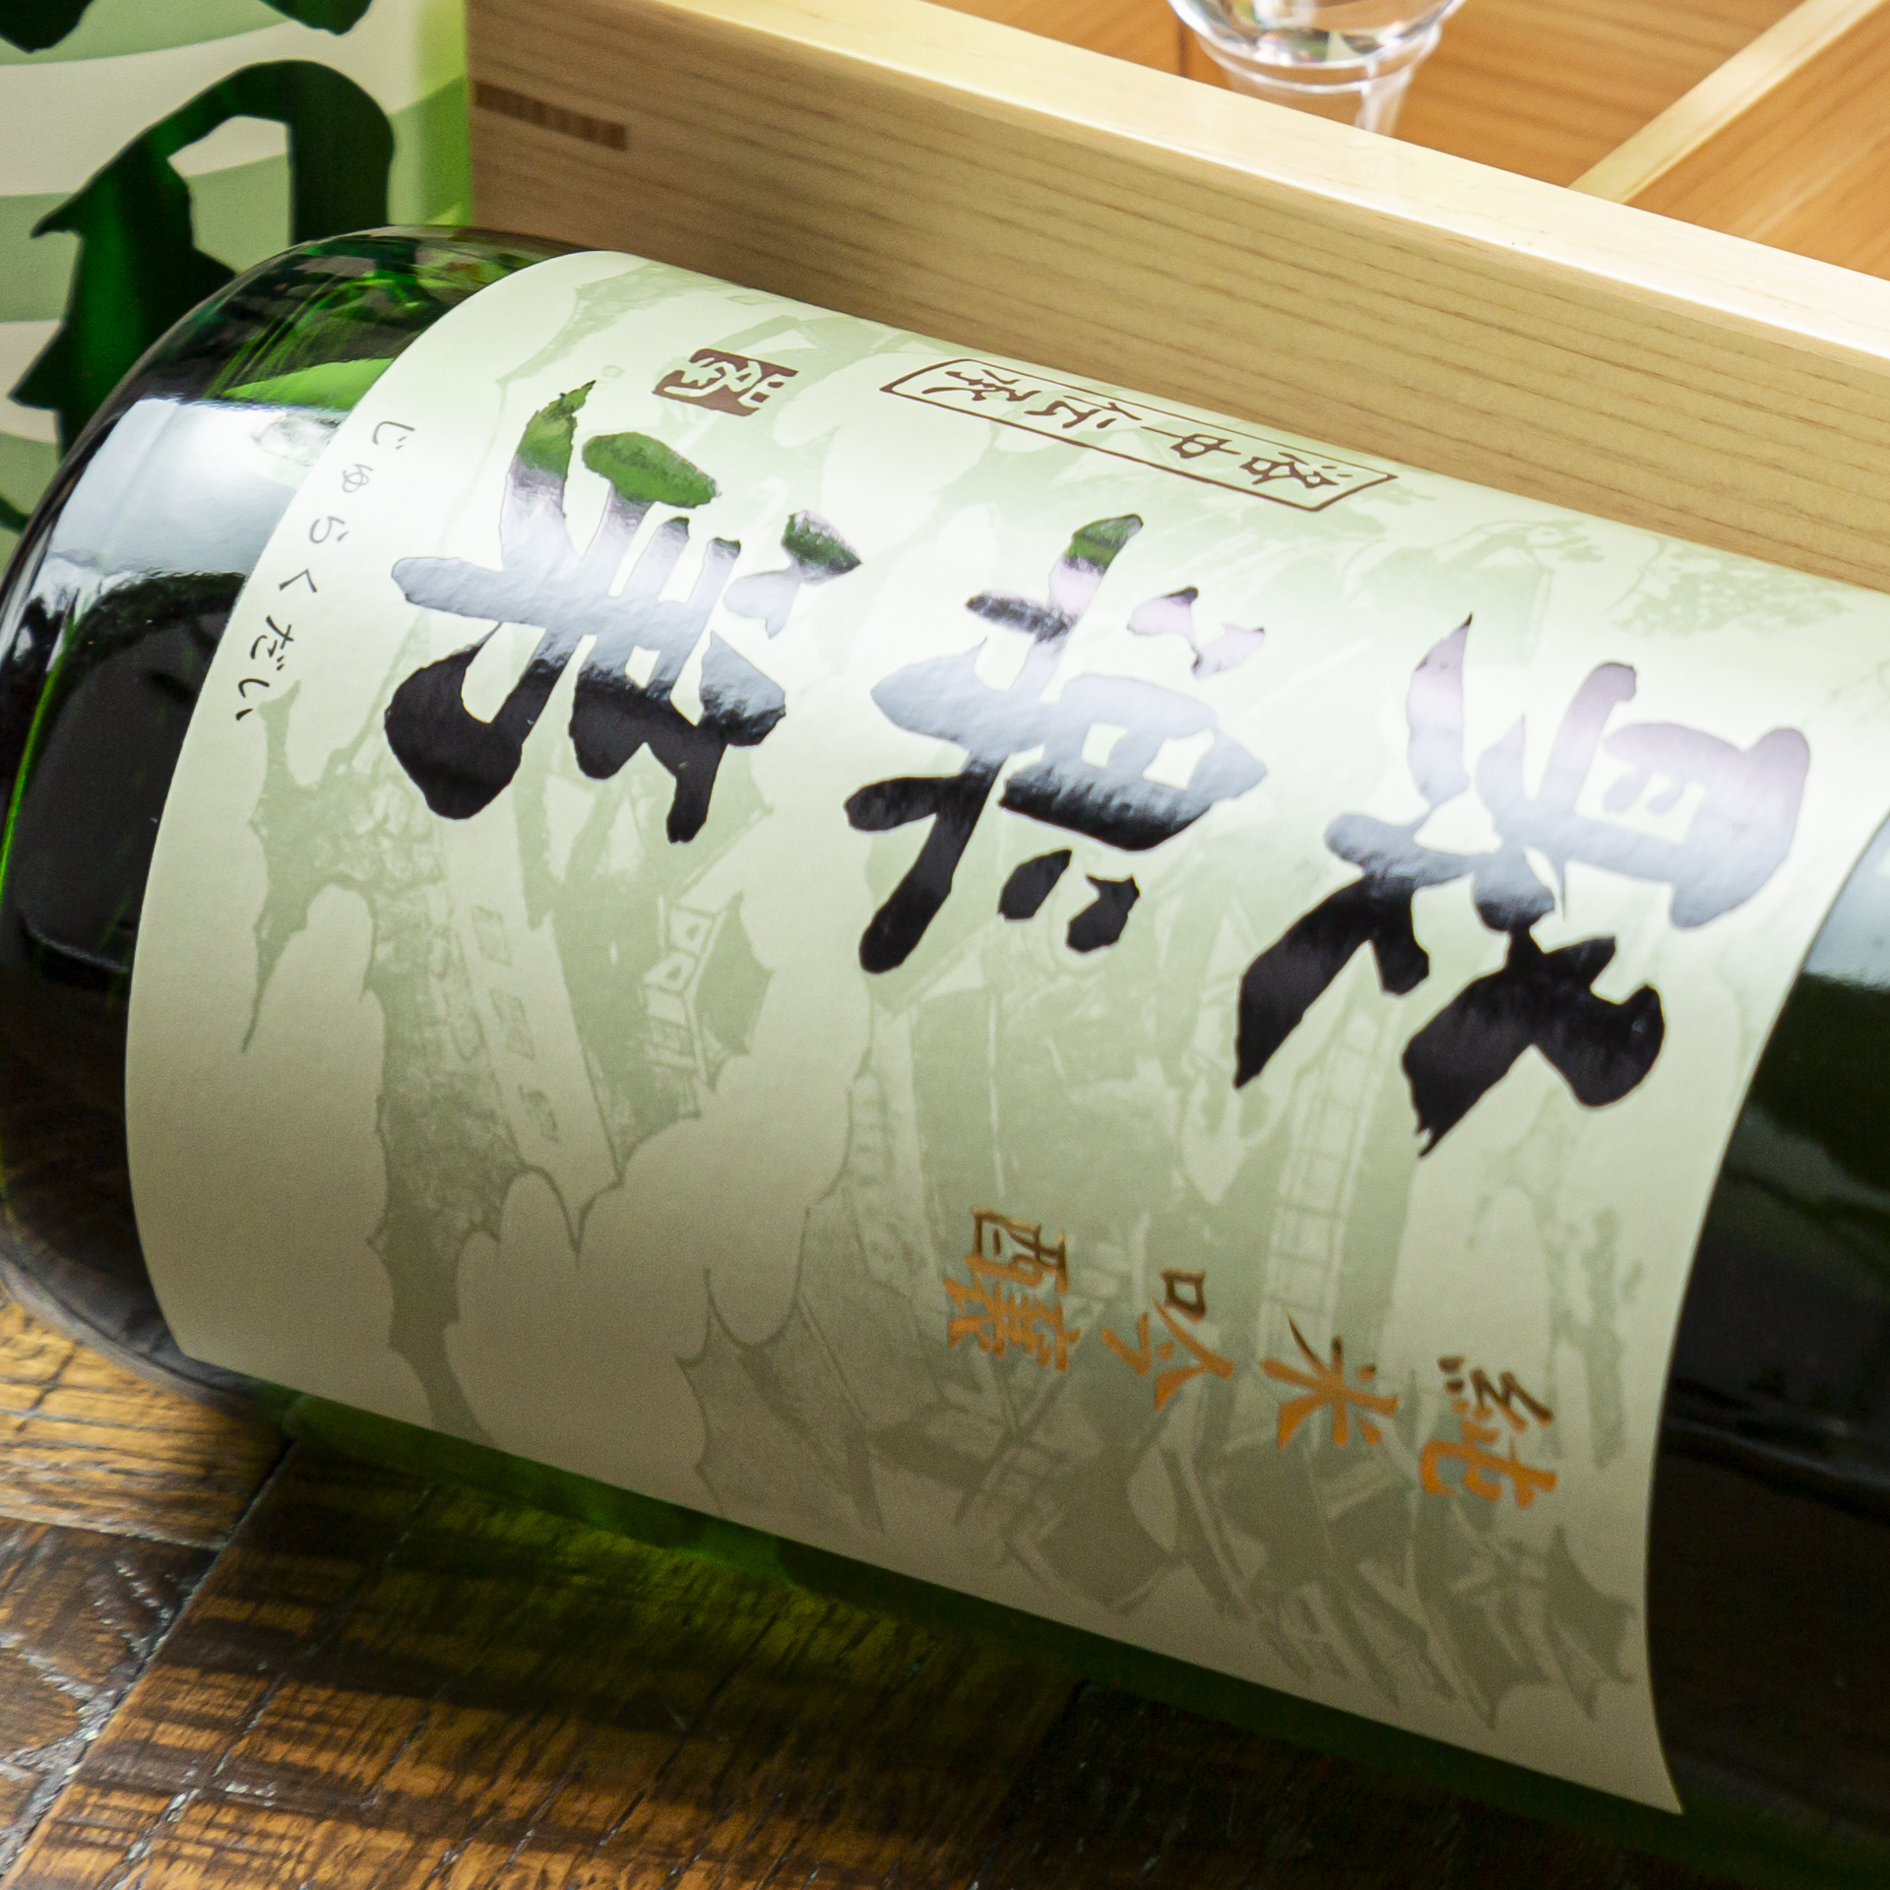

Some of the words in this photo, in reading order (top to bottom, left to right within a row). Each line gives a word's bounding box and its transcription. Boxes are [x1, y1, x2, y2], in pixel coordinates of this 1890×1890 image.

[234, 418, 417, 723] じゅらくだい
[922, 367, 1358, 489] 洛中伝承
[384, 379, 1815, 1157] 聚楽第
[942, 1205, 1559, 1509] 純米吟醸
